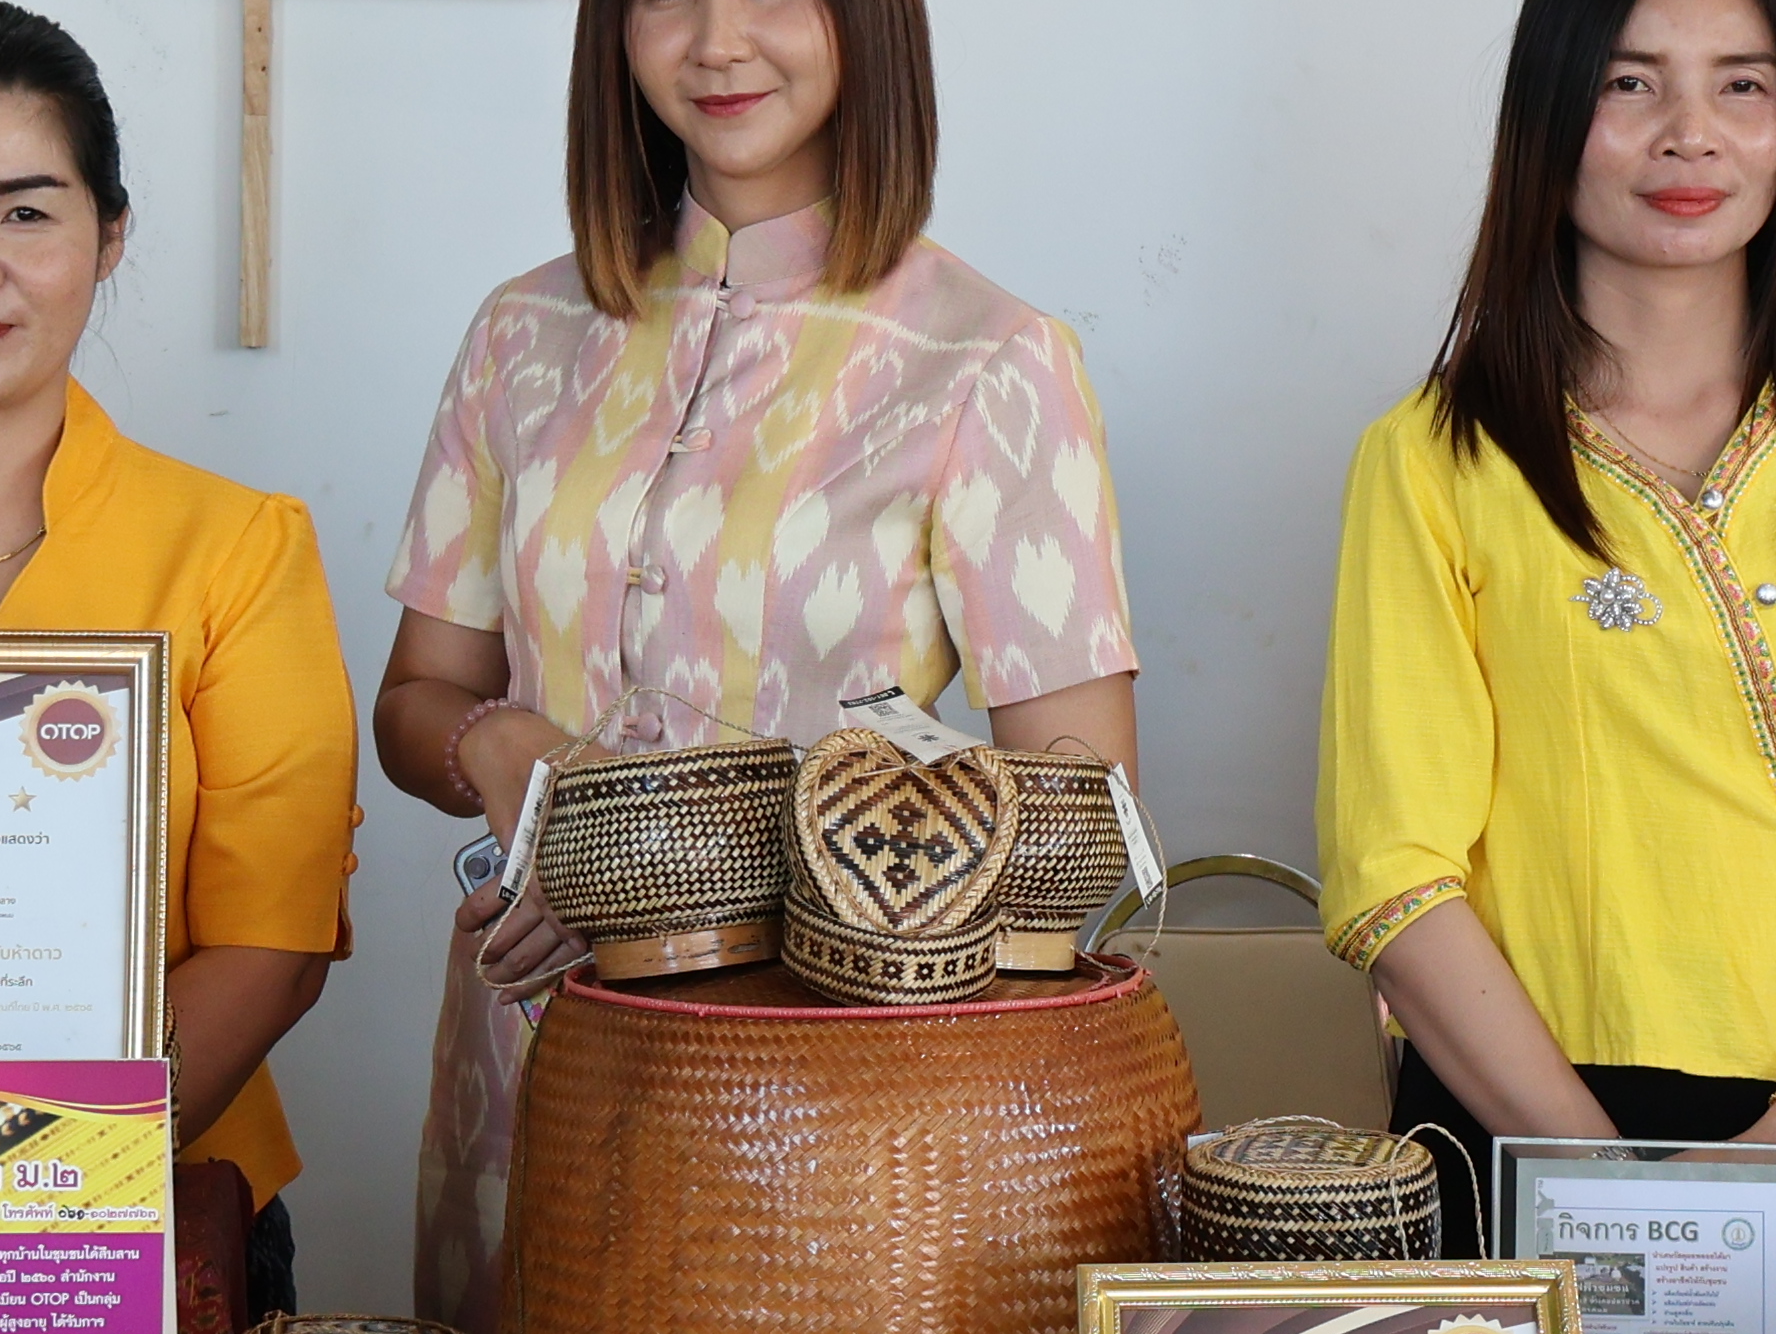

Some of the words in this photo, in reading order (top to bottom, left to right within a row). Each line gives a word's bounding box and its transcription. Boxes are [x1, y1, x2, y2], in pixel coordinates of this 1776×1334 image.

[40, 723, 101, 741] OTOP
[17, 1160, 81, 1190] ม.๒
[3, 1203, 53, 1220] โทรศัพท์
[1558, 1212, 1640, 1241] กิจการ
[1647, 1220, 1699, 1242] BCG
[60, 1270, 115, 1283] สำนักงาน
[31, 1293, 70, 1306] OTOP
[74, 1290, 121, 1310] เป็นกลุ่ม
[51, 1313, 105, 1328] ได้รับการ
